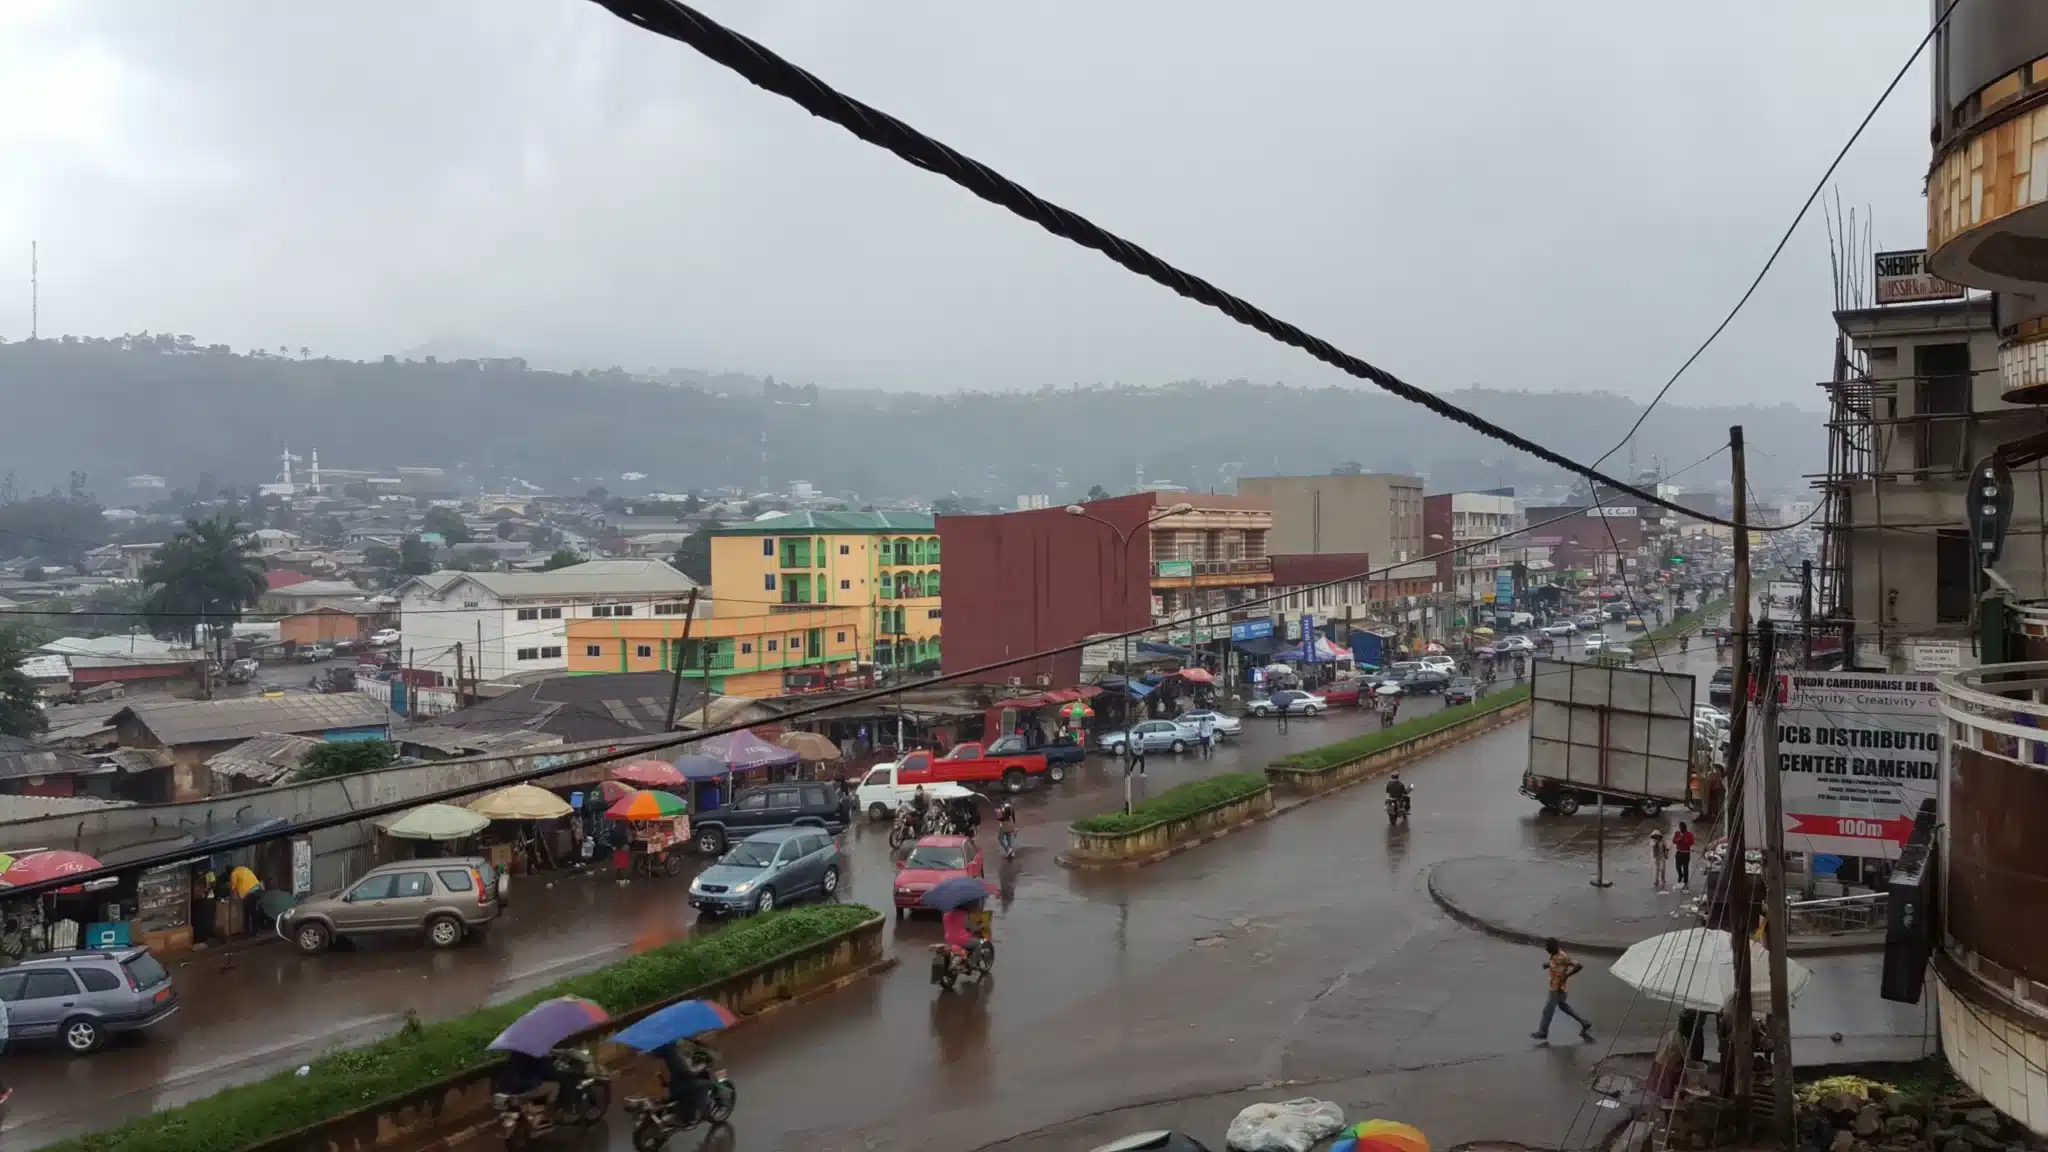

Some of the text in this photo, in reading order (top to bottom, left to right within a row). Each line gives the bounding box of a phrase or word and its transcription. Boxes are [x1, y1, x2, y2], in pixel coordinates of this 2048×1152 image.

[1825, 678, 1903, 691] CAMEROUNAISE
[1905, 682, 1918, 692] DE
[1792, 691, 1845, 705] Integrity
[1856, 694, 1916, 708] Creativity
[1779, 753, 1847, 774] CENTER
[1837, 819, 1883, 837] 100m
